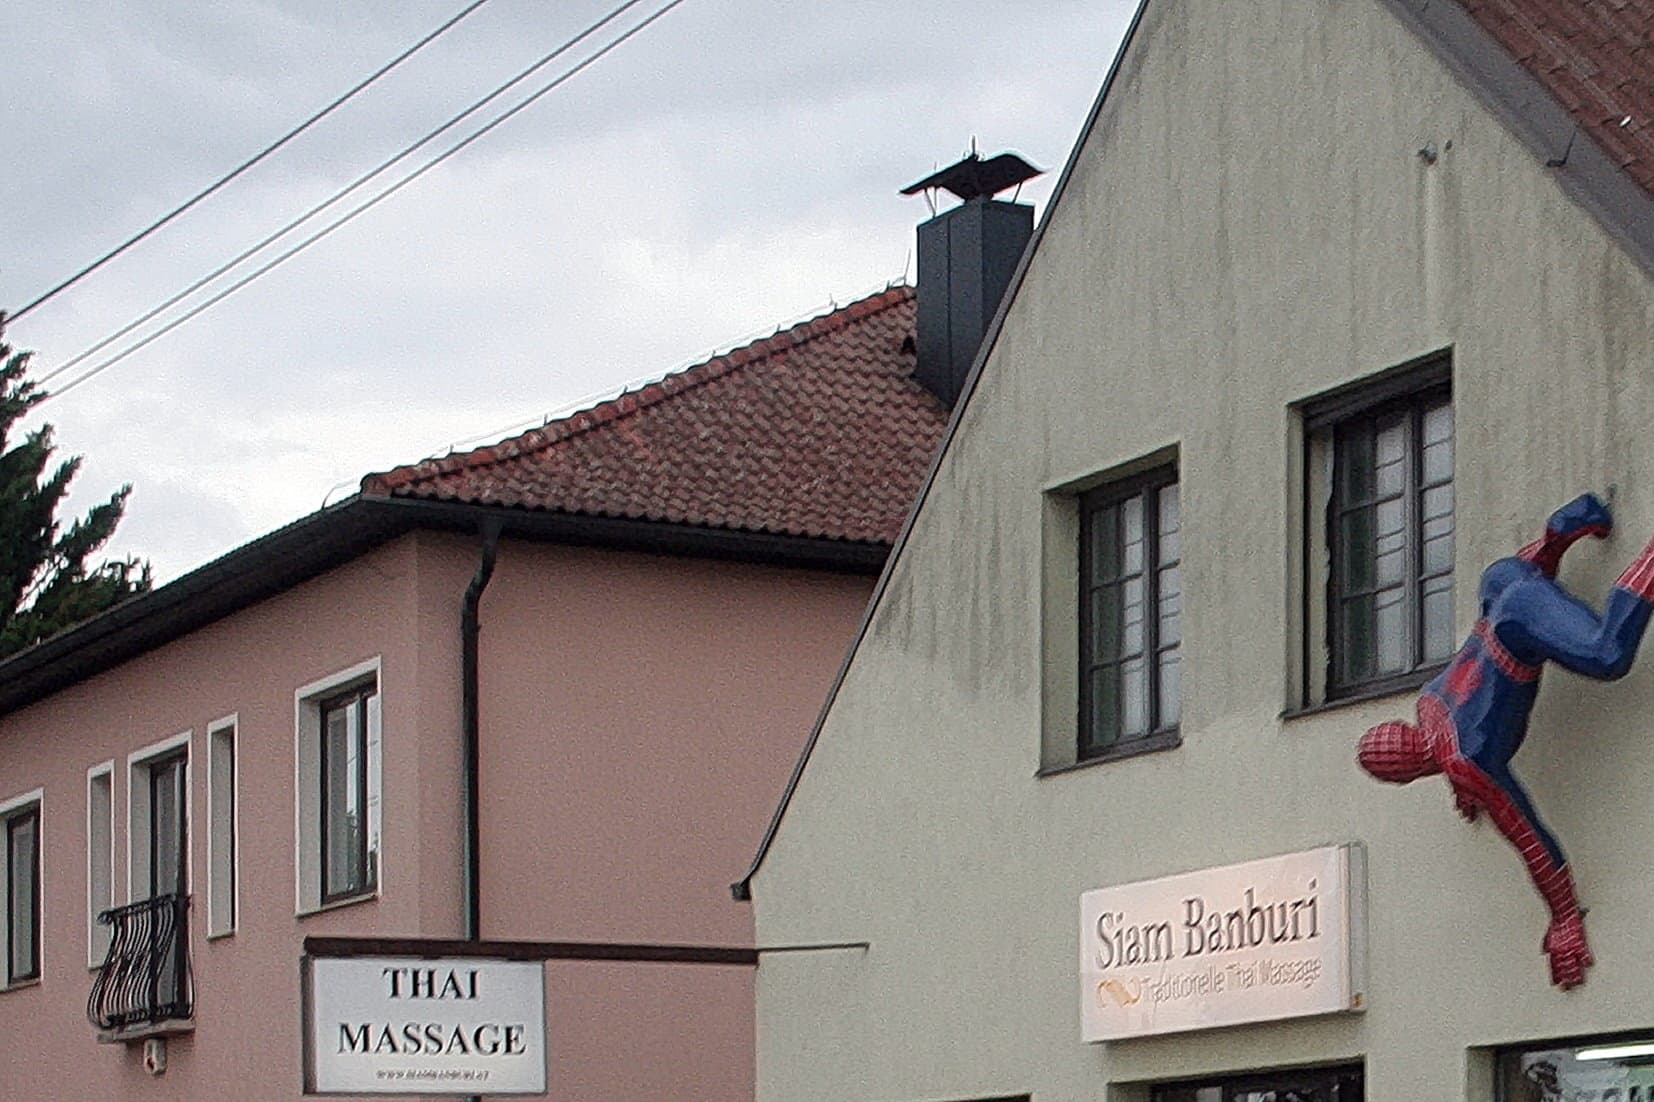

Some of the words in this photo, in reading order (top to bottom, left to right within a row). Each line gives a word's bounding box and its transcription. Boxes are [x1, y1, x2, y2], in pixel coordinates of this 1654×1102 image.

[1095, 911, 1175, 969] Siam
[1182, 877, 1322, 958] Banburi
[381, 966, 482, 999] THAI
[1258, 956, 1322, 991] Massage
[336, 1022, 528, 1056] MASSAGE
